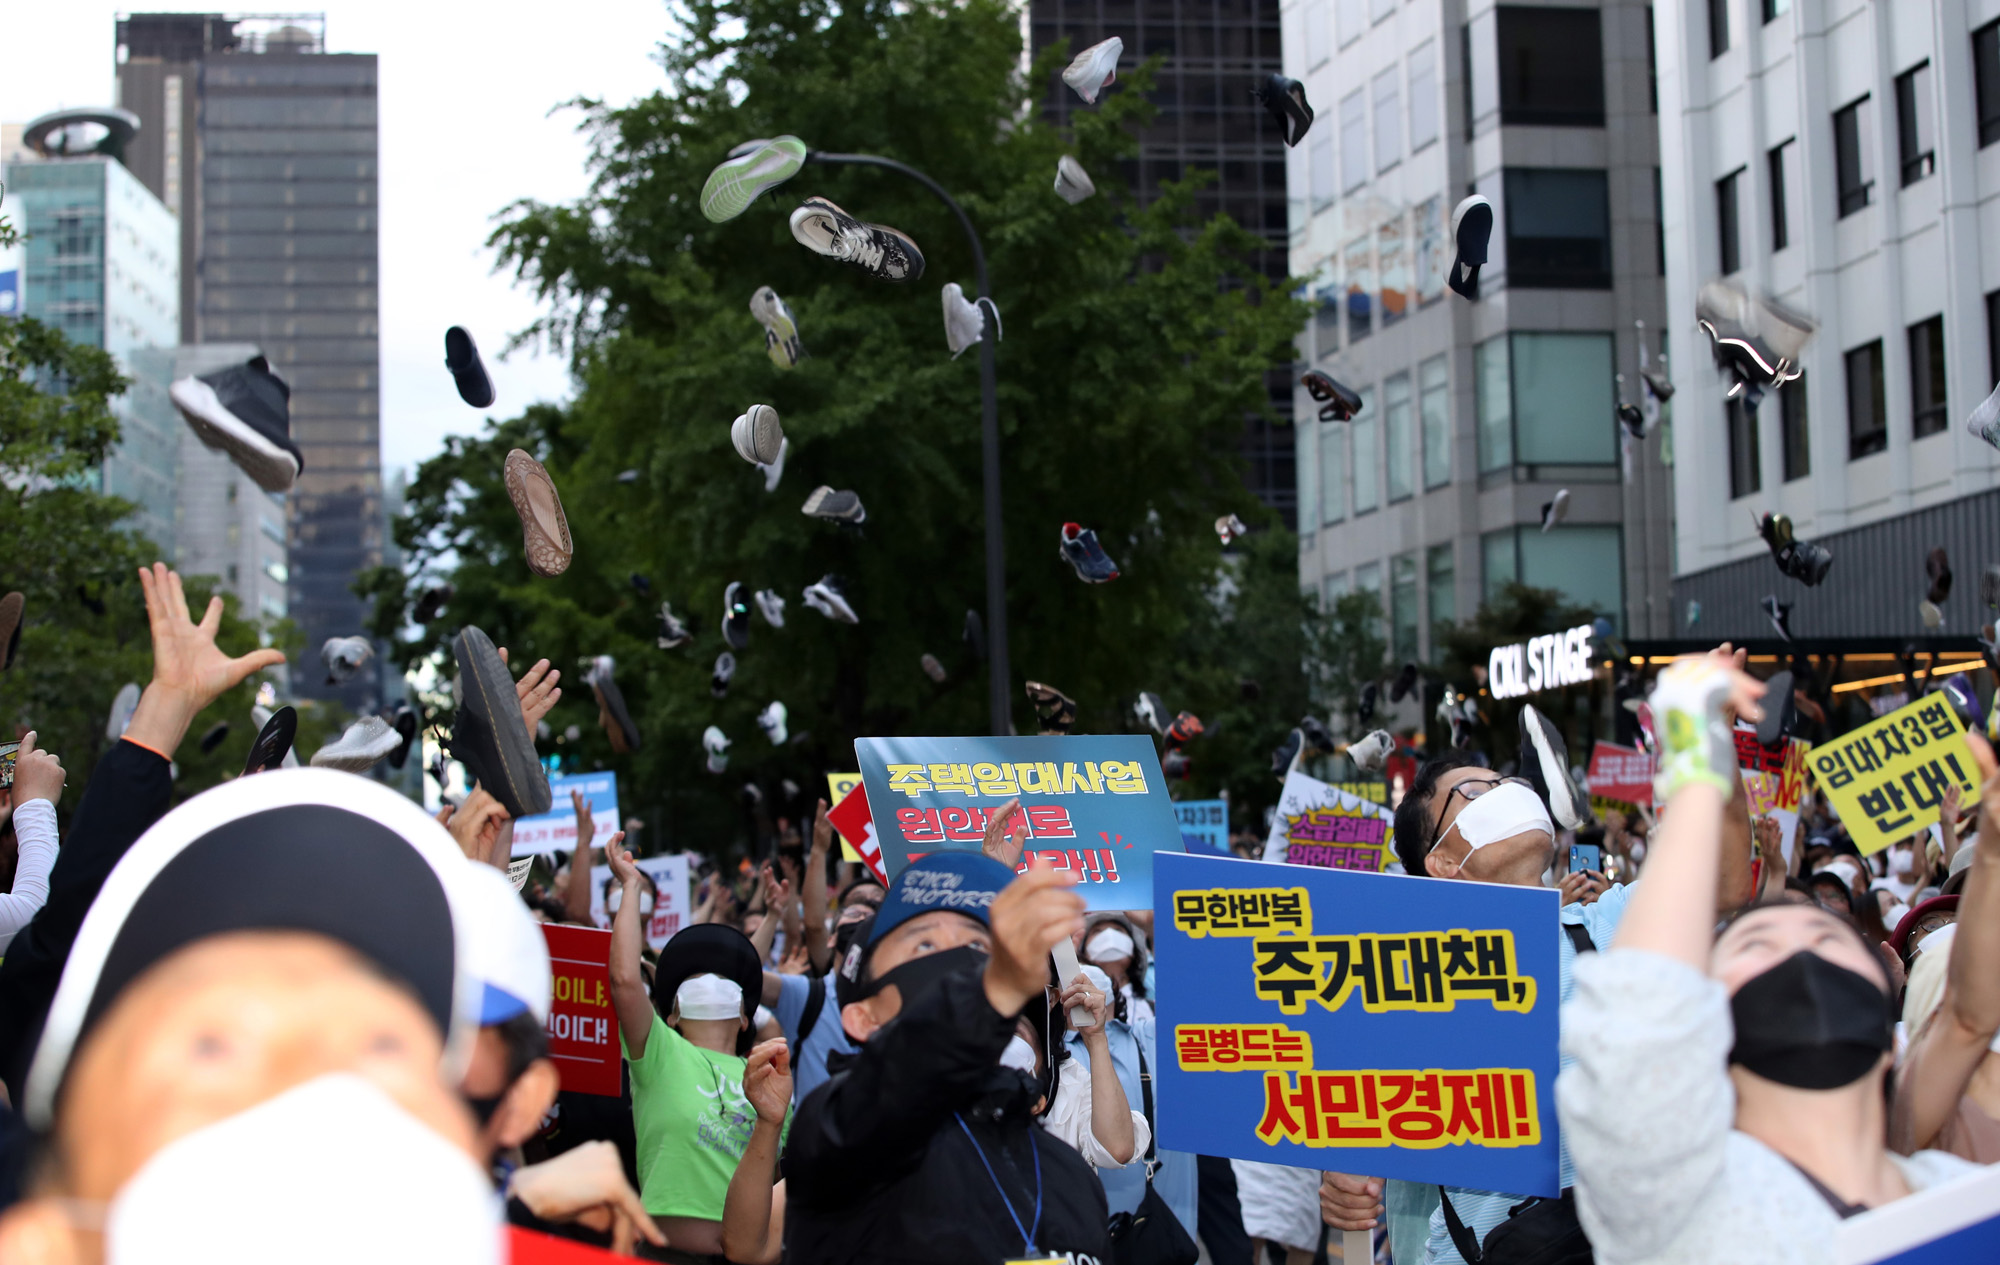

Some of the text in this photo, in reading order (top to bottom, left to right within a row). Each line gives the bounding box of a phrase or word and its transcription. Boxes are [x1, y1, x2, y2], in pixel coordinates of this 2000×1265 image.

[1489, 624, 1593, 700] CKL STAGE
[886, 760, 1149, 798] 주택임대사업
[1816, 702, 1957, 790] 임대차3법
[1857, 753, 1973, 833] 반대!
[1291, 814, 1386, 845] 소급철폐!
[1177, 893, 1303, 930] 무한반복
[1256, 935, 1526, 1006] 주거대책,
[1178, 1029, 1303, 1064] 골병드는
[1259, 1073, 1531, 1140] 서민경제!
